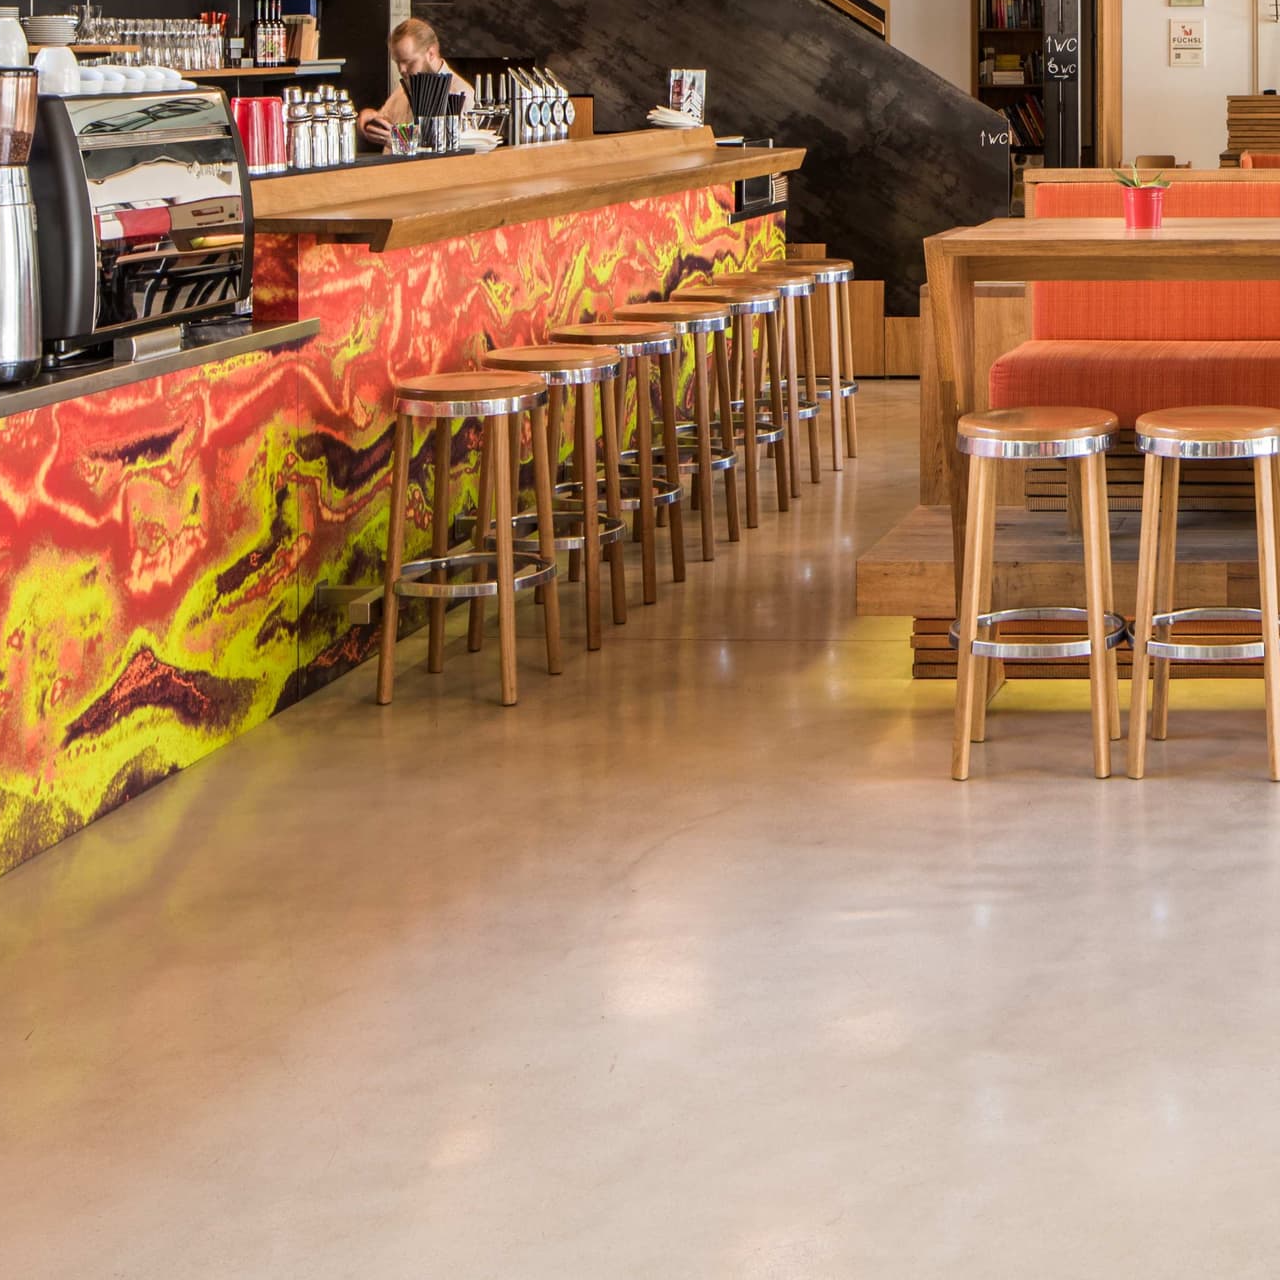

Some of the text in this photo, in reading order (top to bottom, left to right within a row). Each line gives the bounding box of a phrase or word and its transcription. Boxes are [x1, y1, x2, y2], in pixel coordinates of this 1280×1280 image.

[1054, 38, 1077, 52] WC
[1061, 63, 1077, 74] WC
[988, 132, 1009, 145] WC
